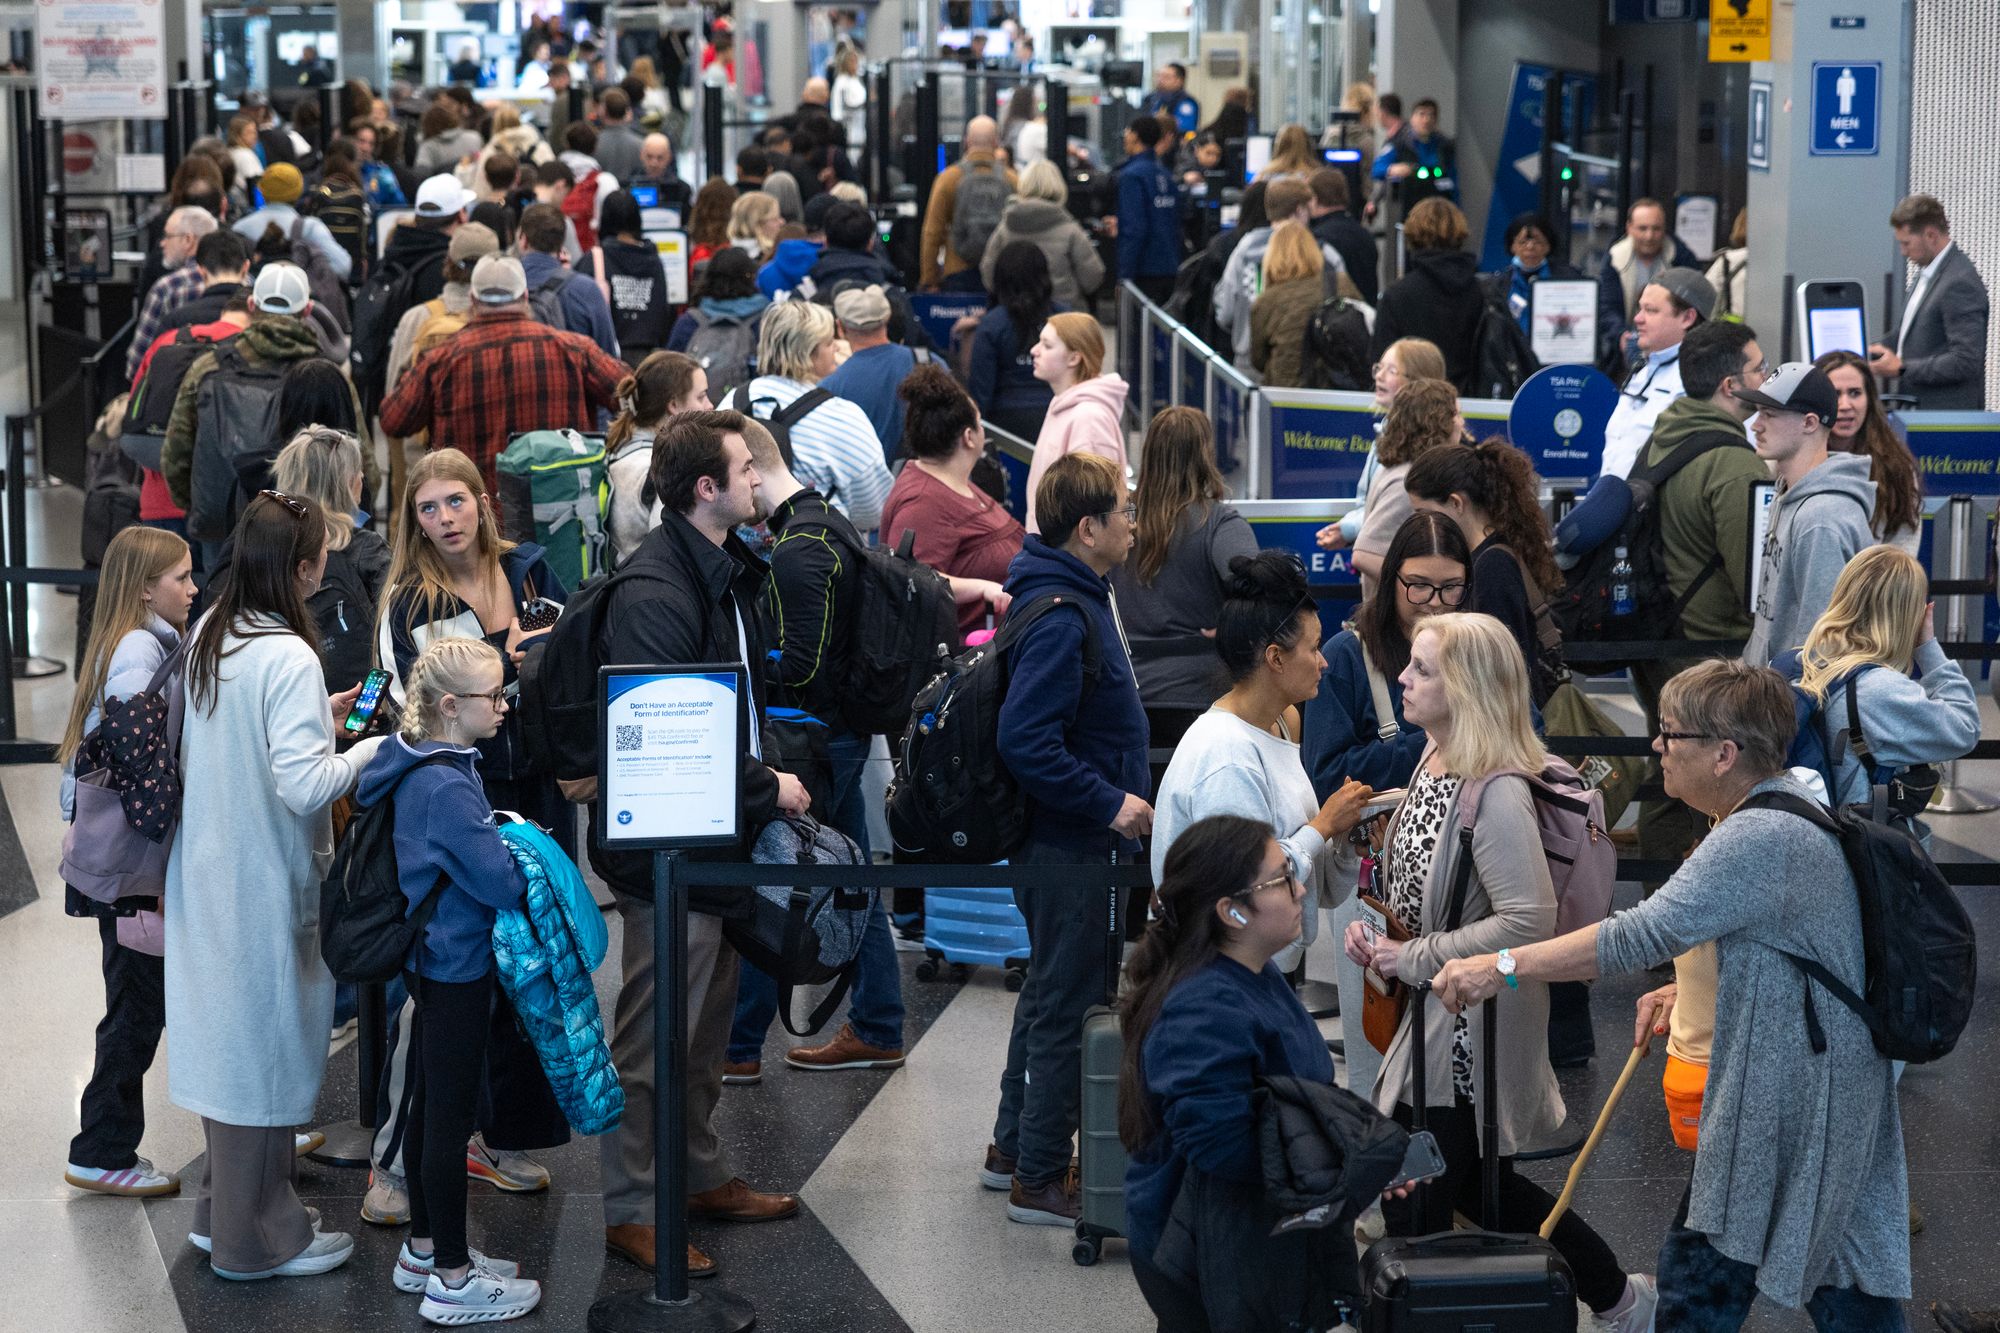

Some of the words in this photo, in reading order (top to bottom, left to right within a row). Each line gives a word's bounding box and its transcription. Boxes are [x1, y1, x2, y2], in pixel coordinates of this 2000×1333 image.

[1830, 116, 1860, 130] MEN
[1283, 431, 1347, 451] Welcome
[1543, 449, 1567, 458] Enroll
[1569, 449, 1588, 459] Now
[1919, 454, 1993, 475] Welcome
[677, 700, 713, 709] Acceptable
[661, 709, 709, 717] Identification?
